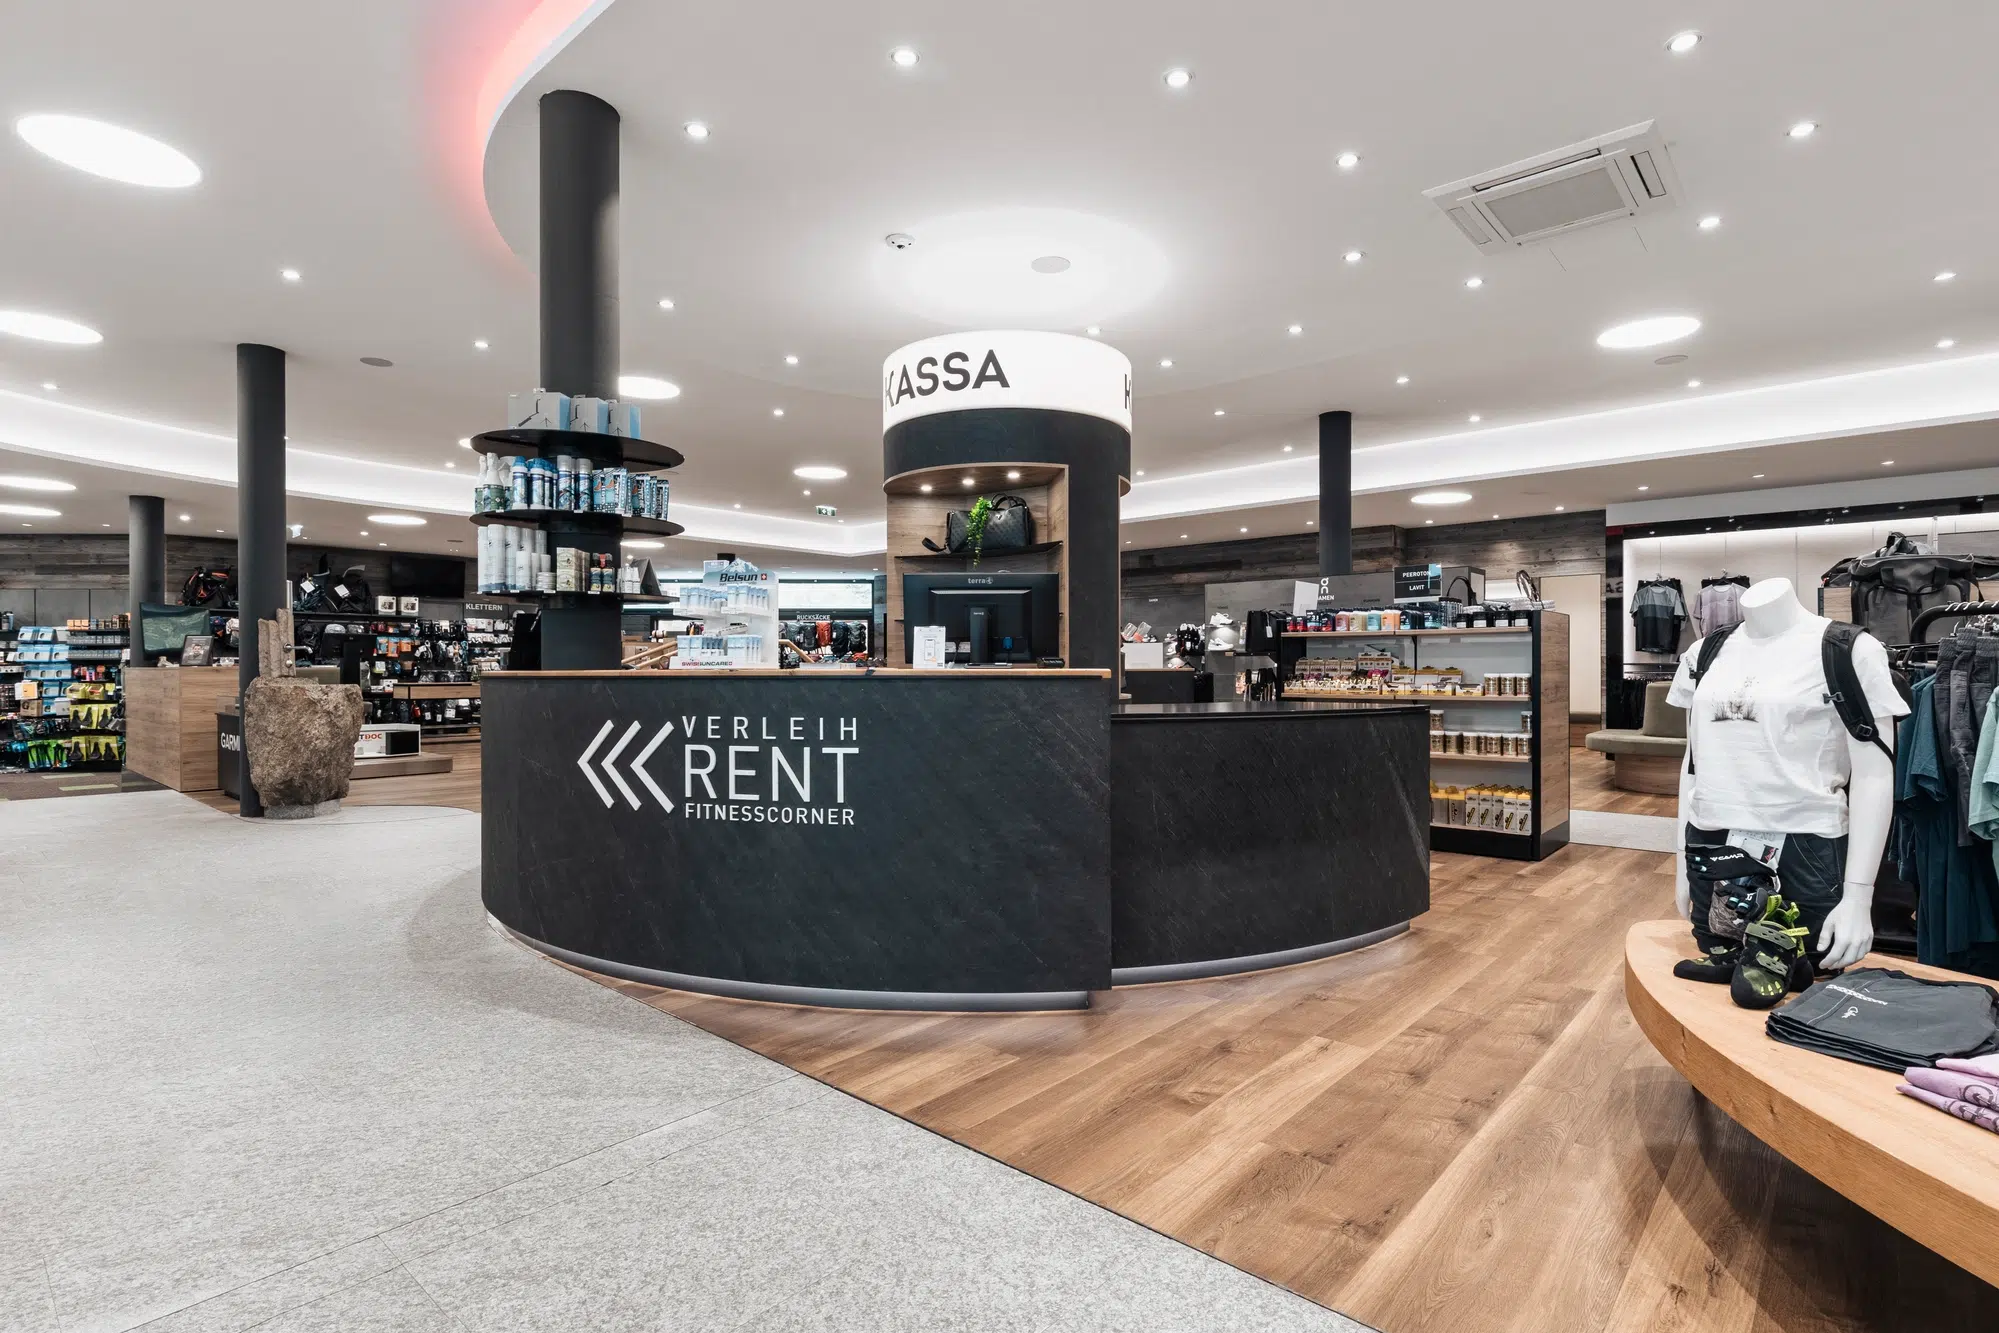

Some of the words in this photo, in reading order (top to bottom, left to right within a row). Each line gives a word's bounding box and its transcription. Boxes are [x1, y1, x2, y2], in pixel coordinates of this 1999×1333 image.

[885, 349, 1010, 412] KASSA
[719, 572, 758, 583] Belsun
[465, 603, 503, 611] KLETTERN
[682, 716, 857, 741] VERLEIH
[685, 744, 859, 803] RENT
[685, 802, 855, 826] FITNESSCORNER
